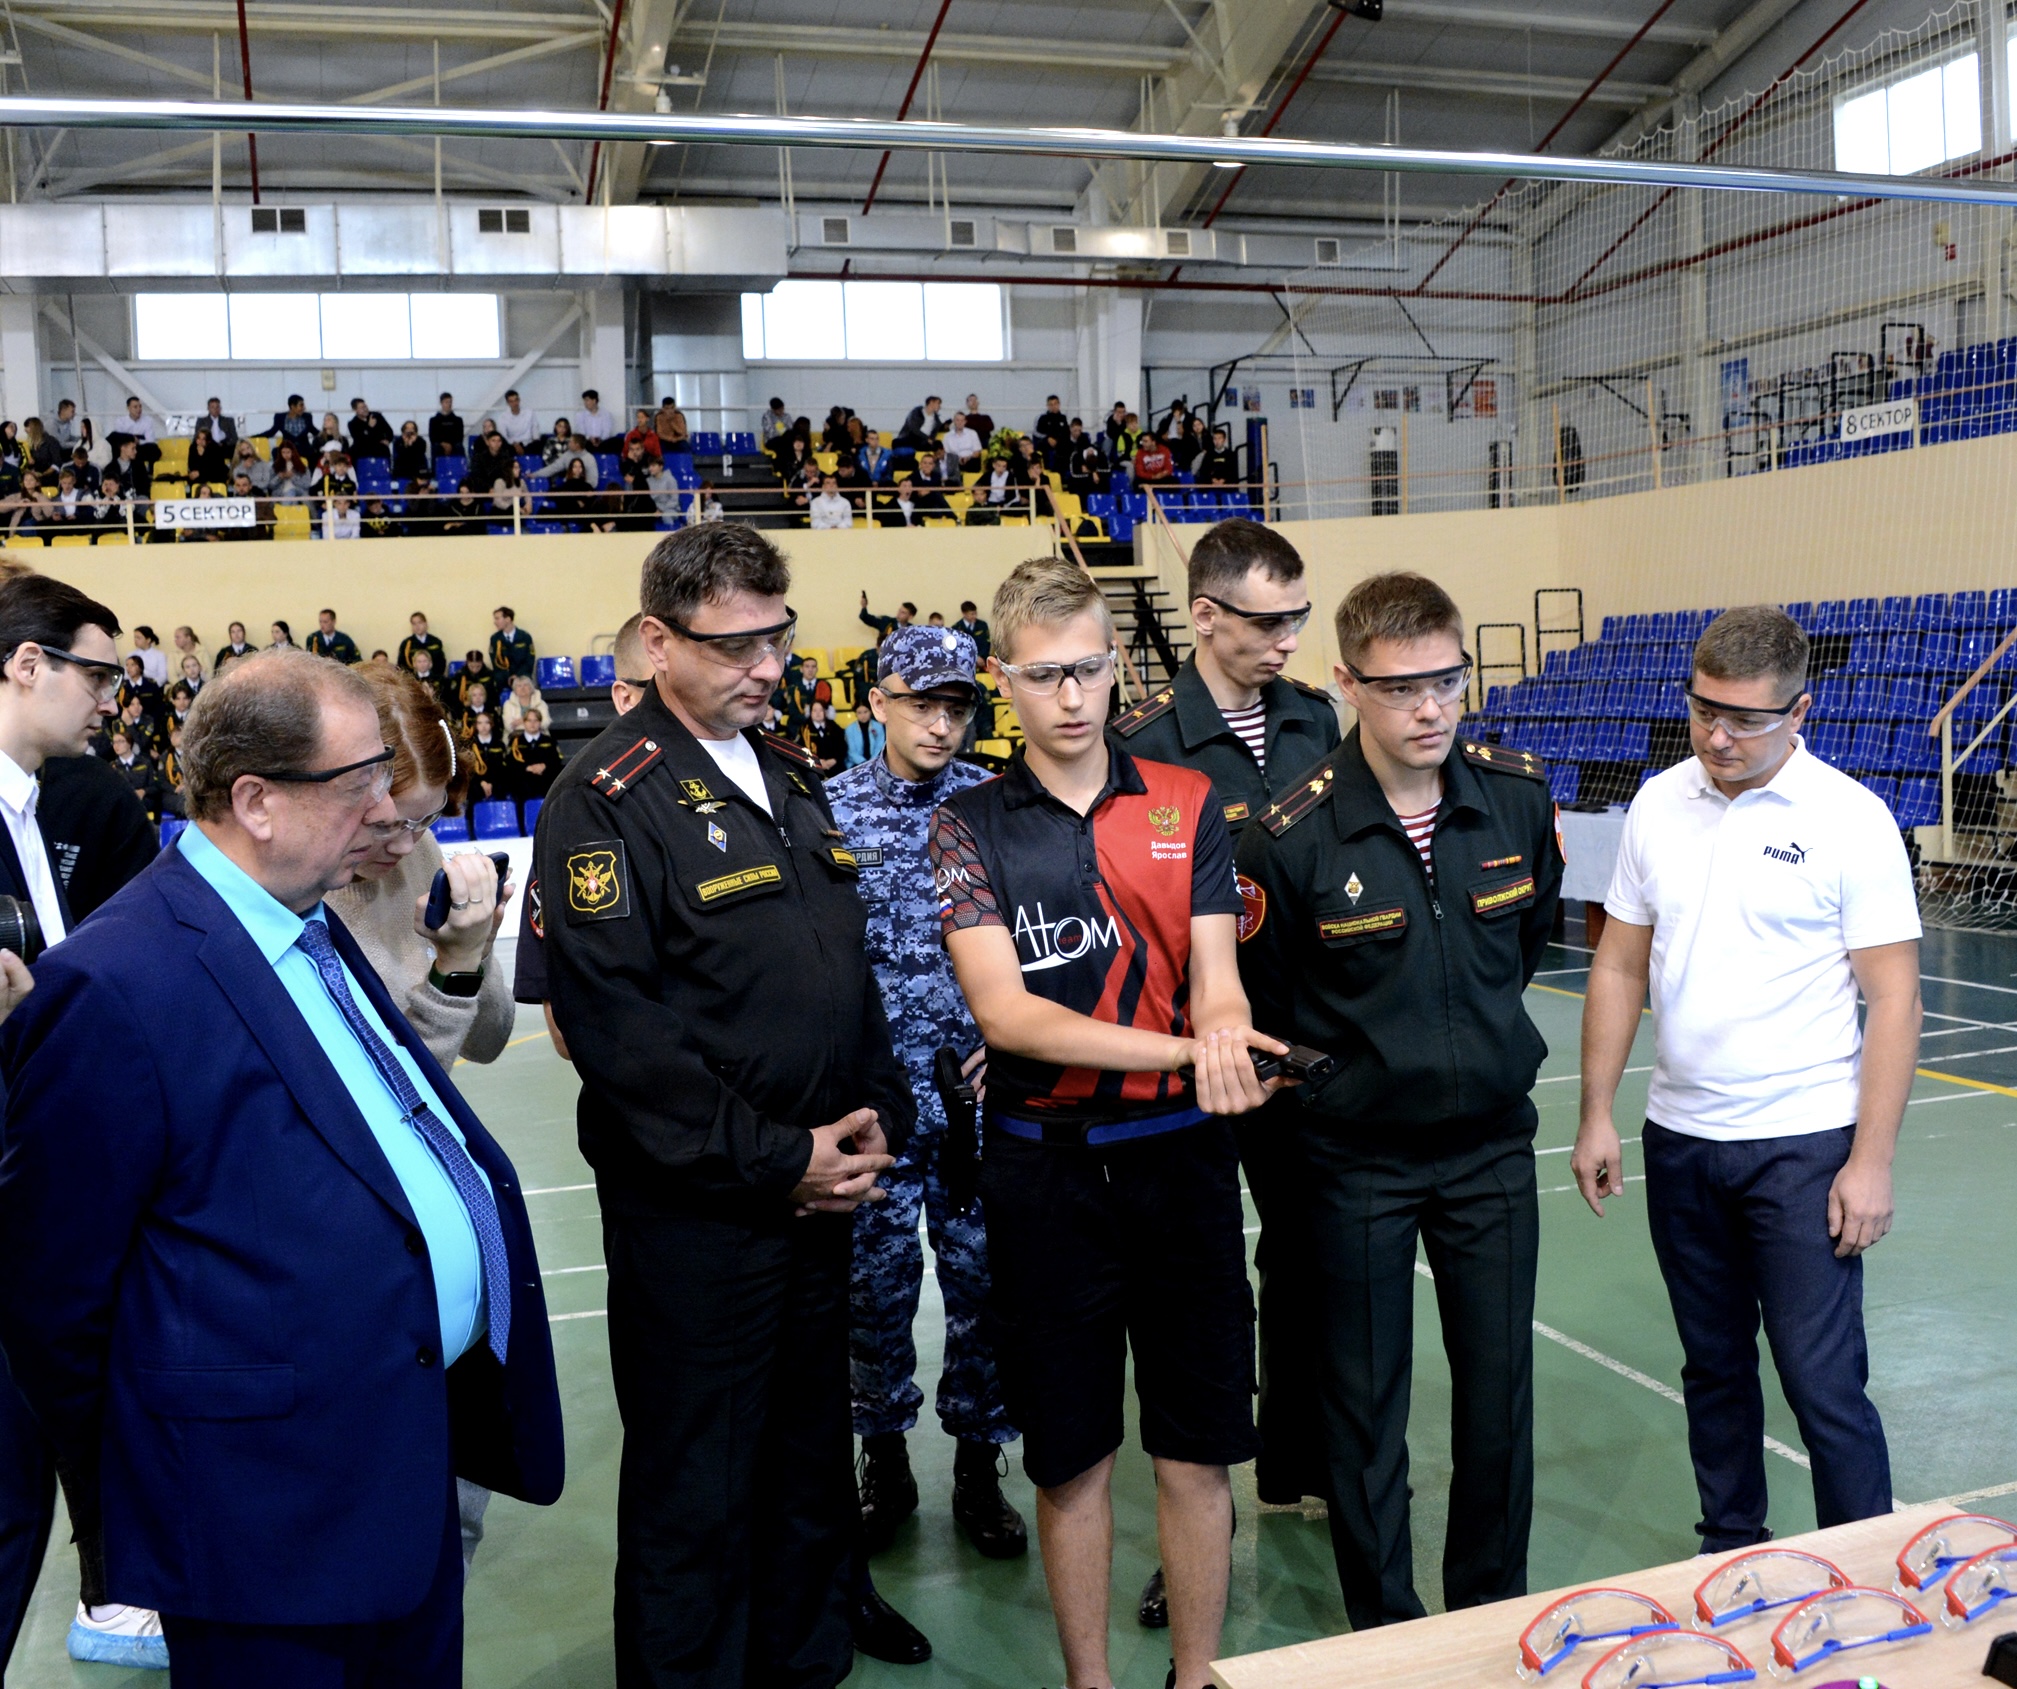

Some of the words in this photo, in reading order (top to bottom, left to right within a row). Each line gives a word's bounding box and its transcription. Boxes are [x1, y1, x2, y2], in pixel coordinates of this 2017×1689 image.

[1846, 414, 1857, 435] 8
[1861, 407, 1912, 430] СЕКТОР
[163, 505, 176, 523] 5
[180, 505, 252, 521] СЕКТОР
[1151, 841, 1187, 850] Давыдов
[1763, 845, 1800, 865] PUMA
[1152, 851, 1188, 860] Ярослав
[1477, 887, 1518, 907] ПРИВОЛЖСКИЙ
[1517, 882, 1533, 894] ОКРУГ
